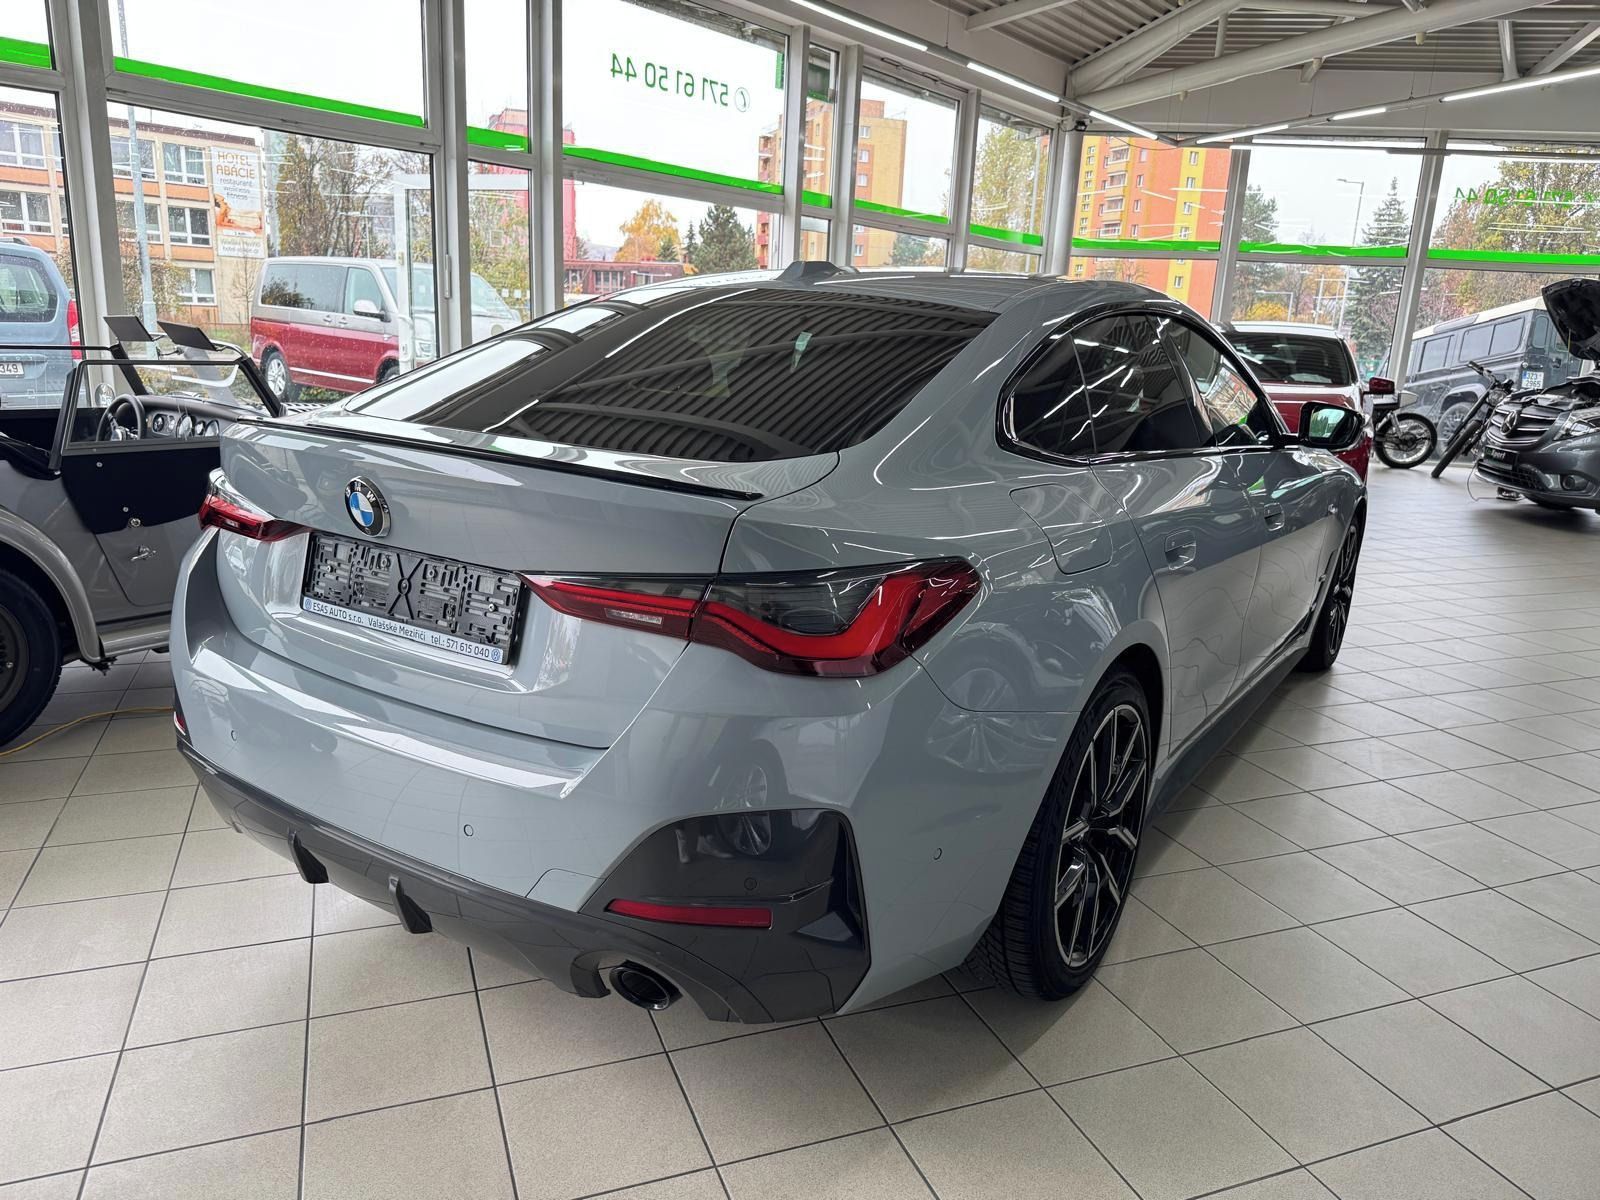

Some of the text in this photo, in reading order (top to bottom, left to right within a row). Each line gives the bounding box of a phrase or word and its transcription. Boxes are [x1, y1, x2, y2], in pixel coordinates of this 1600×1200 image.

[217, 151, 252, 166] HOTEL
[216, 164, 255, 179] ABÁCIE
[313, 602, 328, 614] ESAS
[329, 607, 348, 619] AUTO
[348, 613, 364, 624] s.r.o.
[431, 635, 445, 647] tel.:
[446, 638, 458, 650] 571
[460, 642, 473, 653] 615
[474, 646, 490, 658] 040
